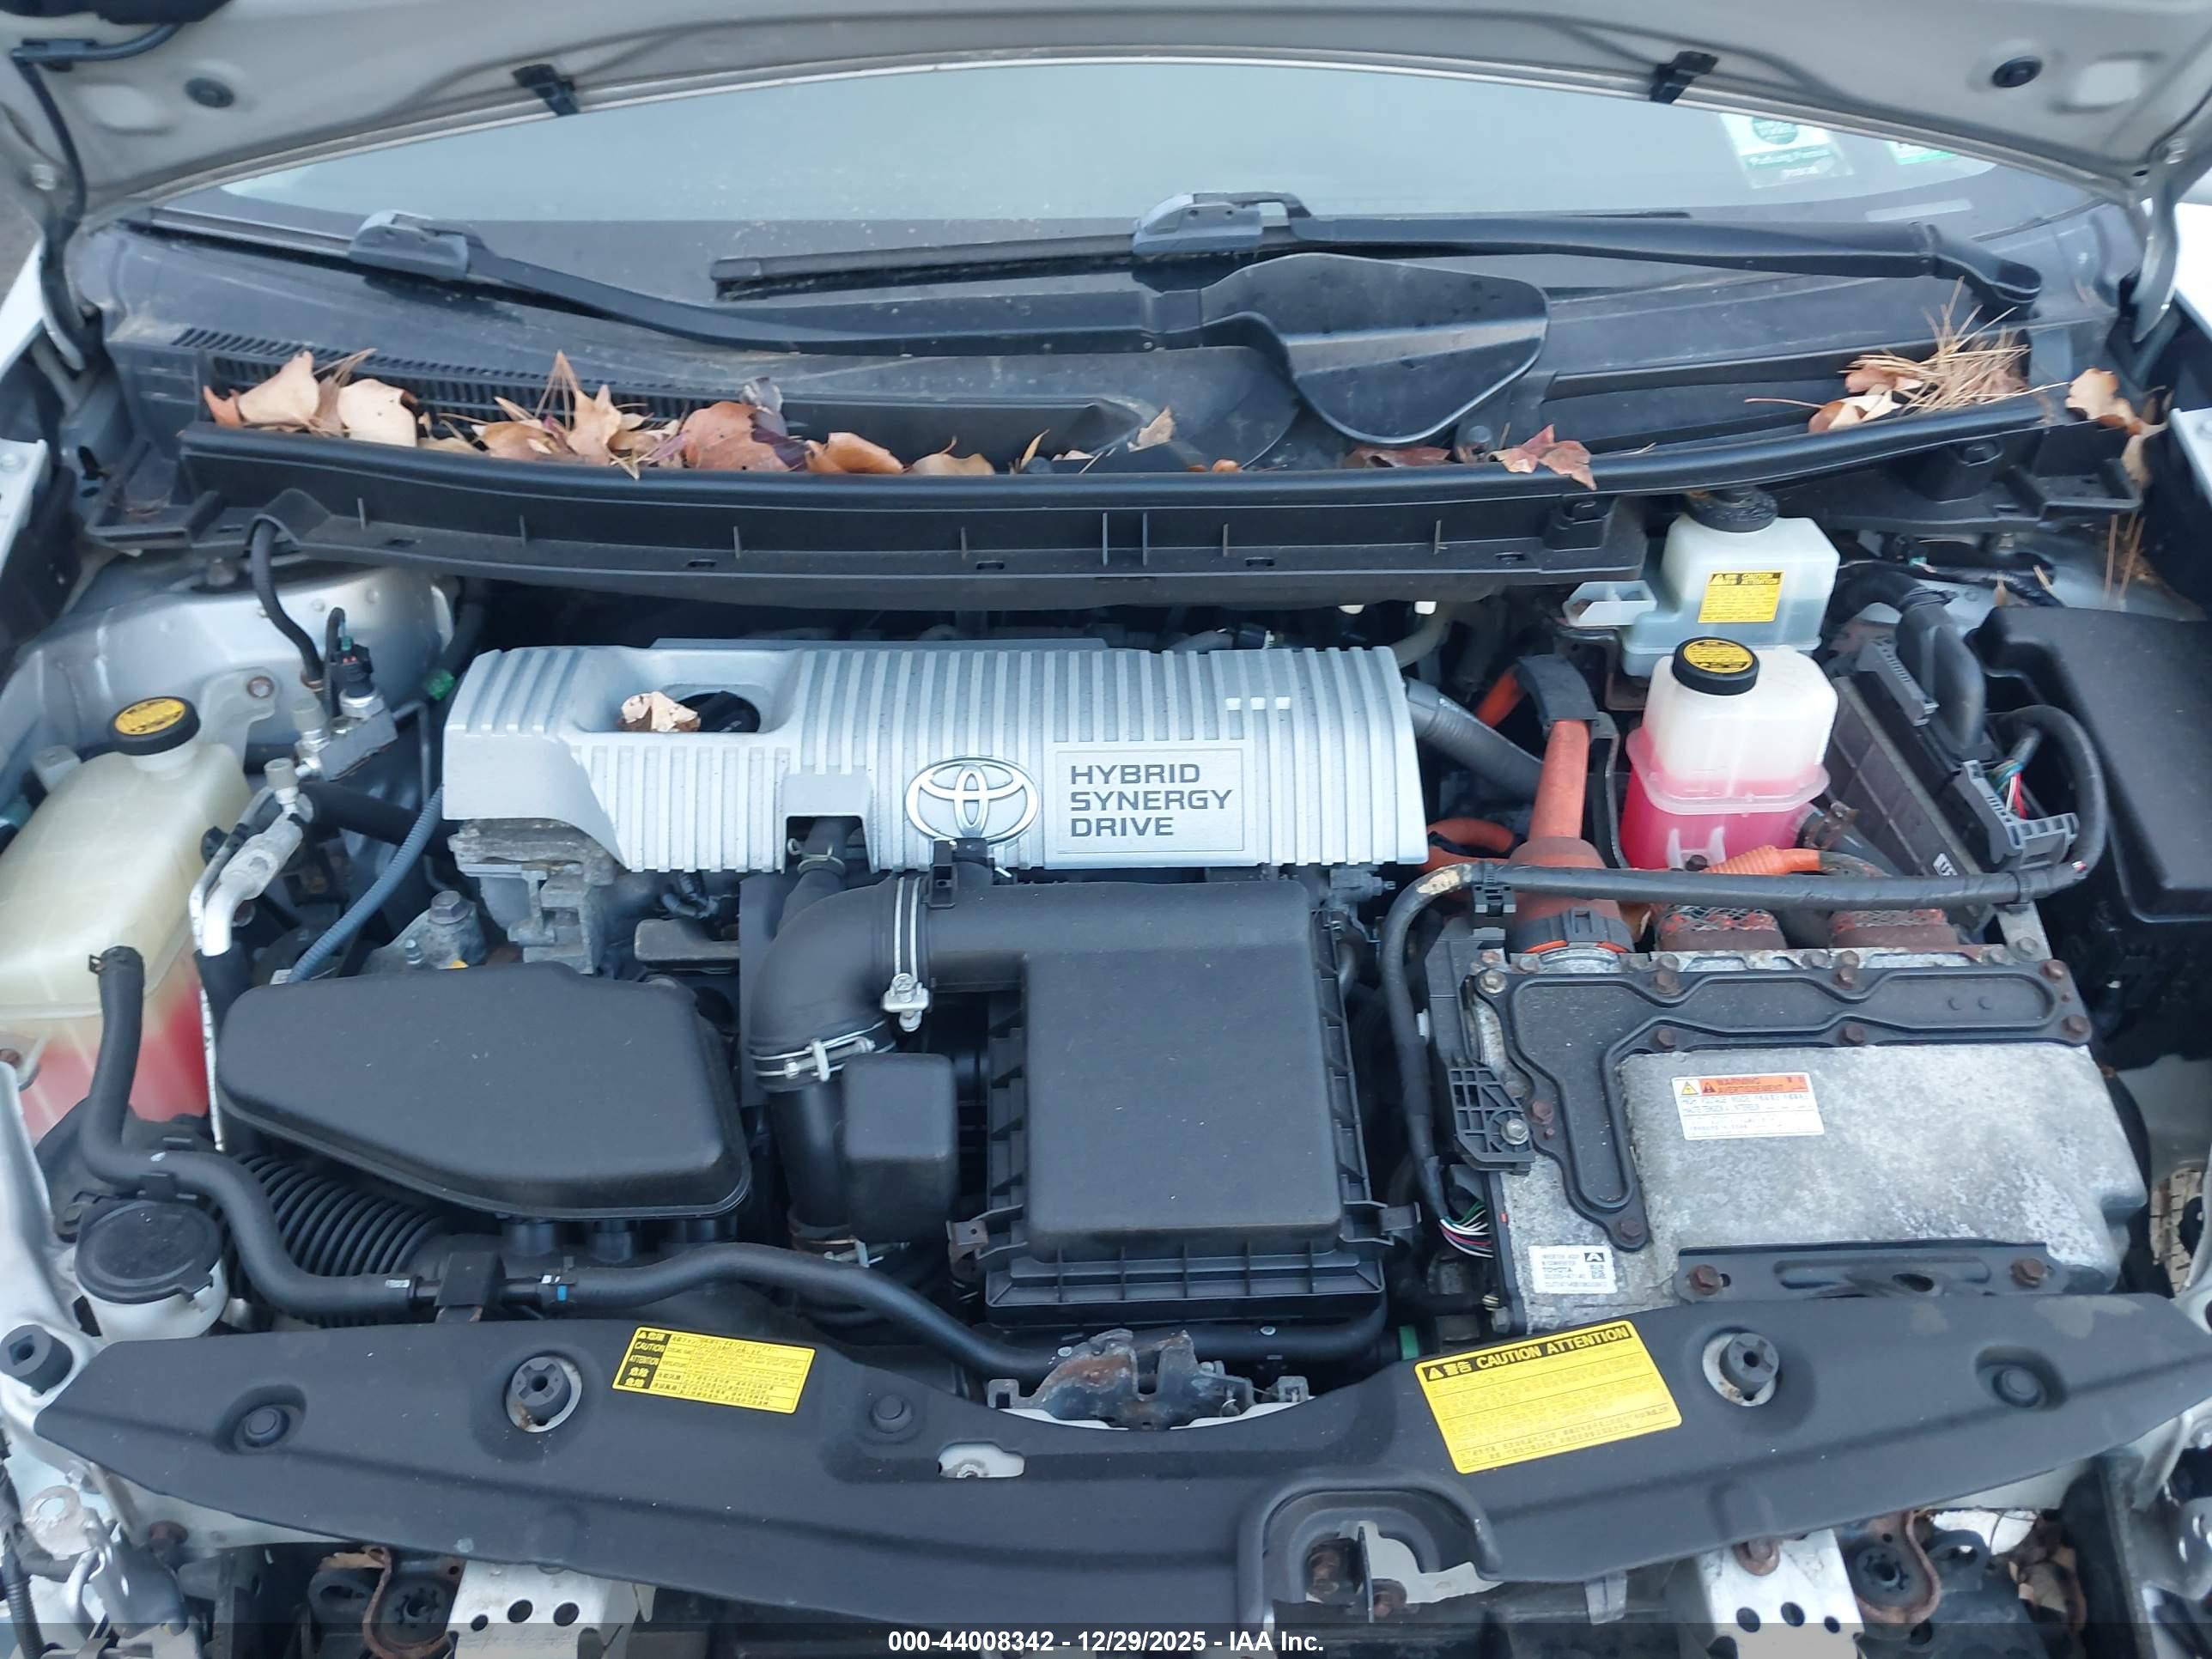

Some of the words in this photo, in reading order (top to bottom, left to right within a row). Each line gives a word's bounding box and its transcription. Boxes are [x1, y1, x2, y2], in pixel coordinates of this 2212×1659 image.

[1070, 763, 1200, 785] HYBRID
[1070, 789, 1232, 811] SYNERGY
[1070, 817, 1174, 837] DRIVE
[635, 1341, 666, 1352] CAUTION
[1476, 1346, 1543, 1370] CAUTION
[1545, 1326, 1629, 1355] ATTENTION
[629, 1355, 660, 1365] ATTENTION
